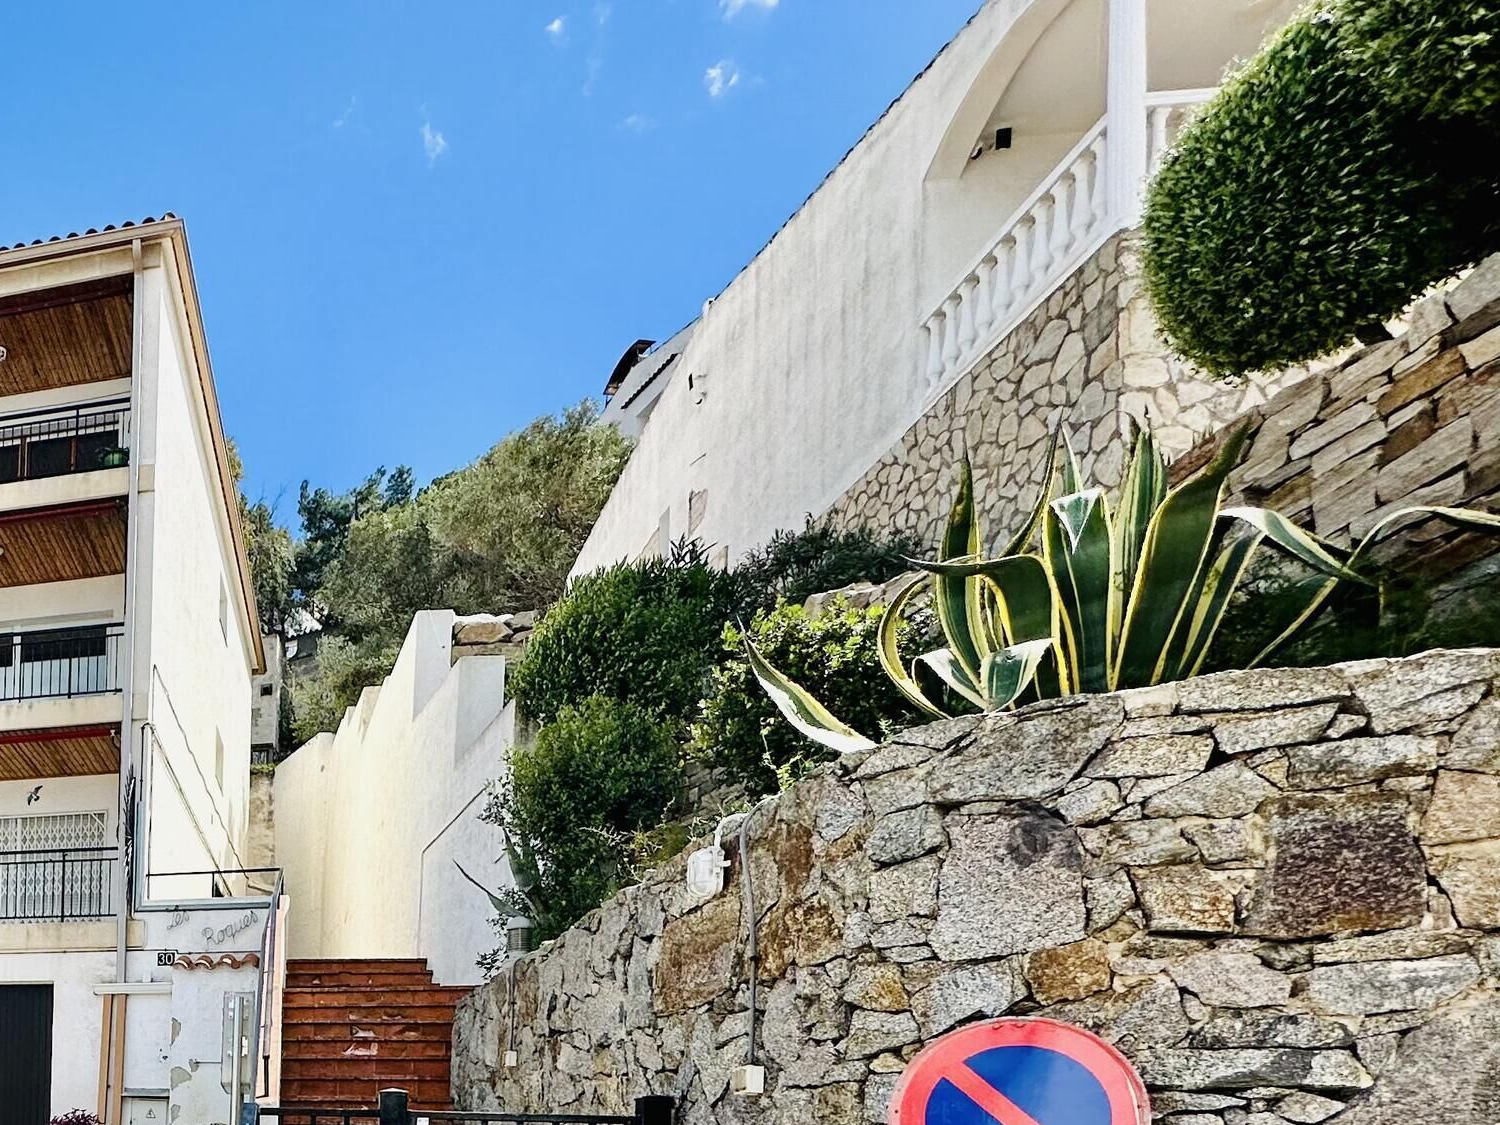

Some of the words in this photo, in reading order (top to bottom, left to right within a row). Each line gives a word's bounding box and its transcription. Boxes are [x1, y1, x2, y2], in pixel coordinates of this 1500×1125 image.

[166, 910, 190, 930] Les
[202, 910, 258, 951] Roques
[158, 953, 174, 965] 30
